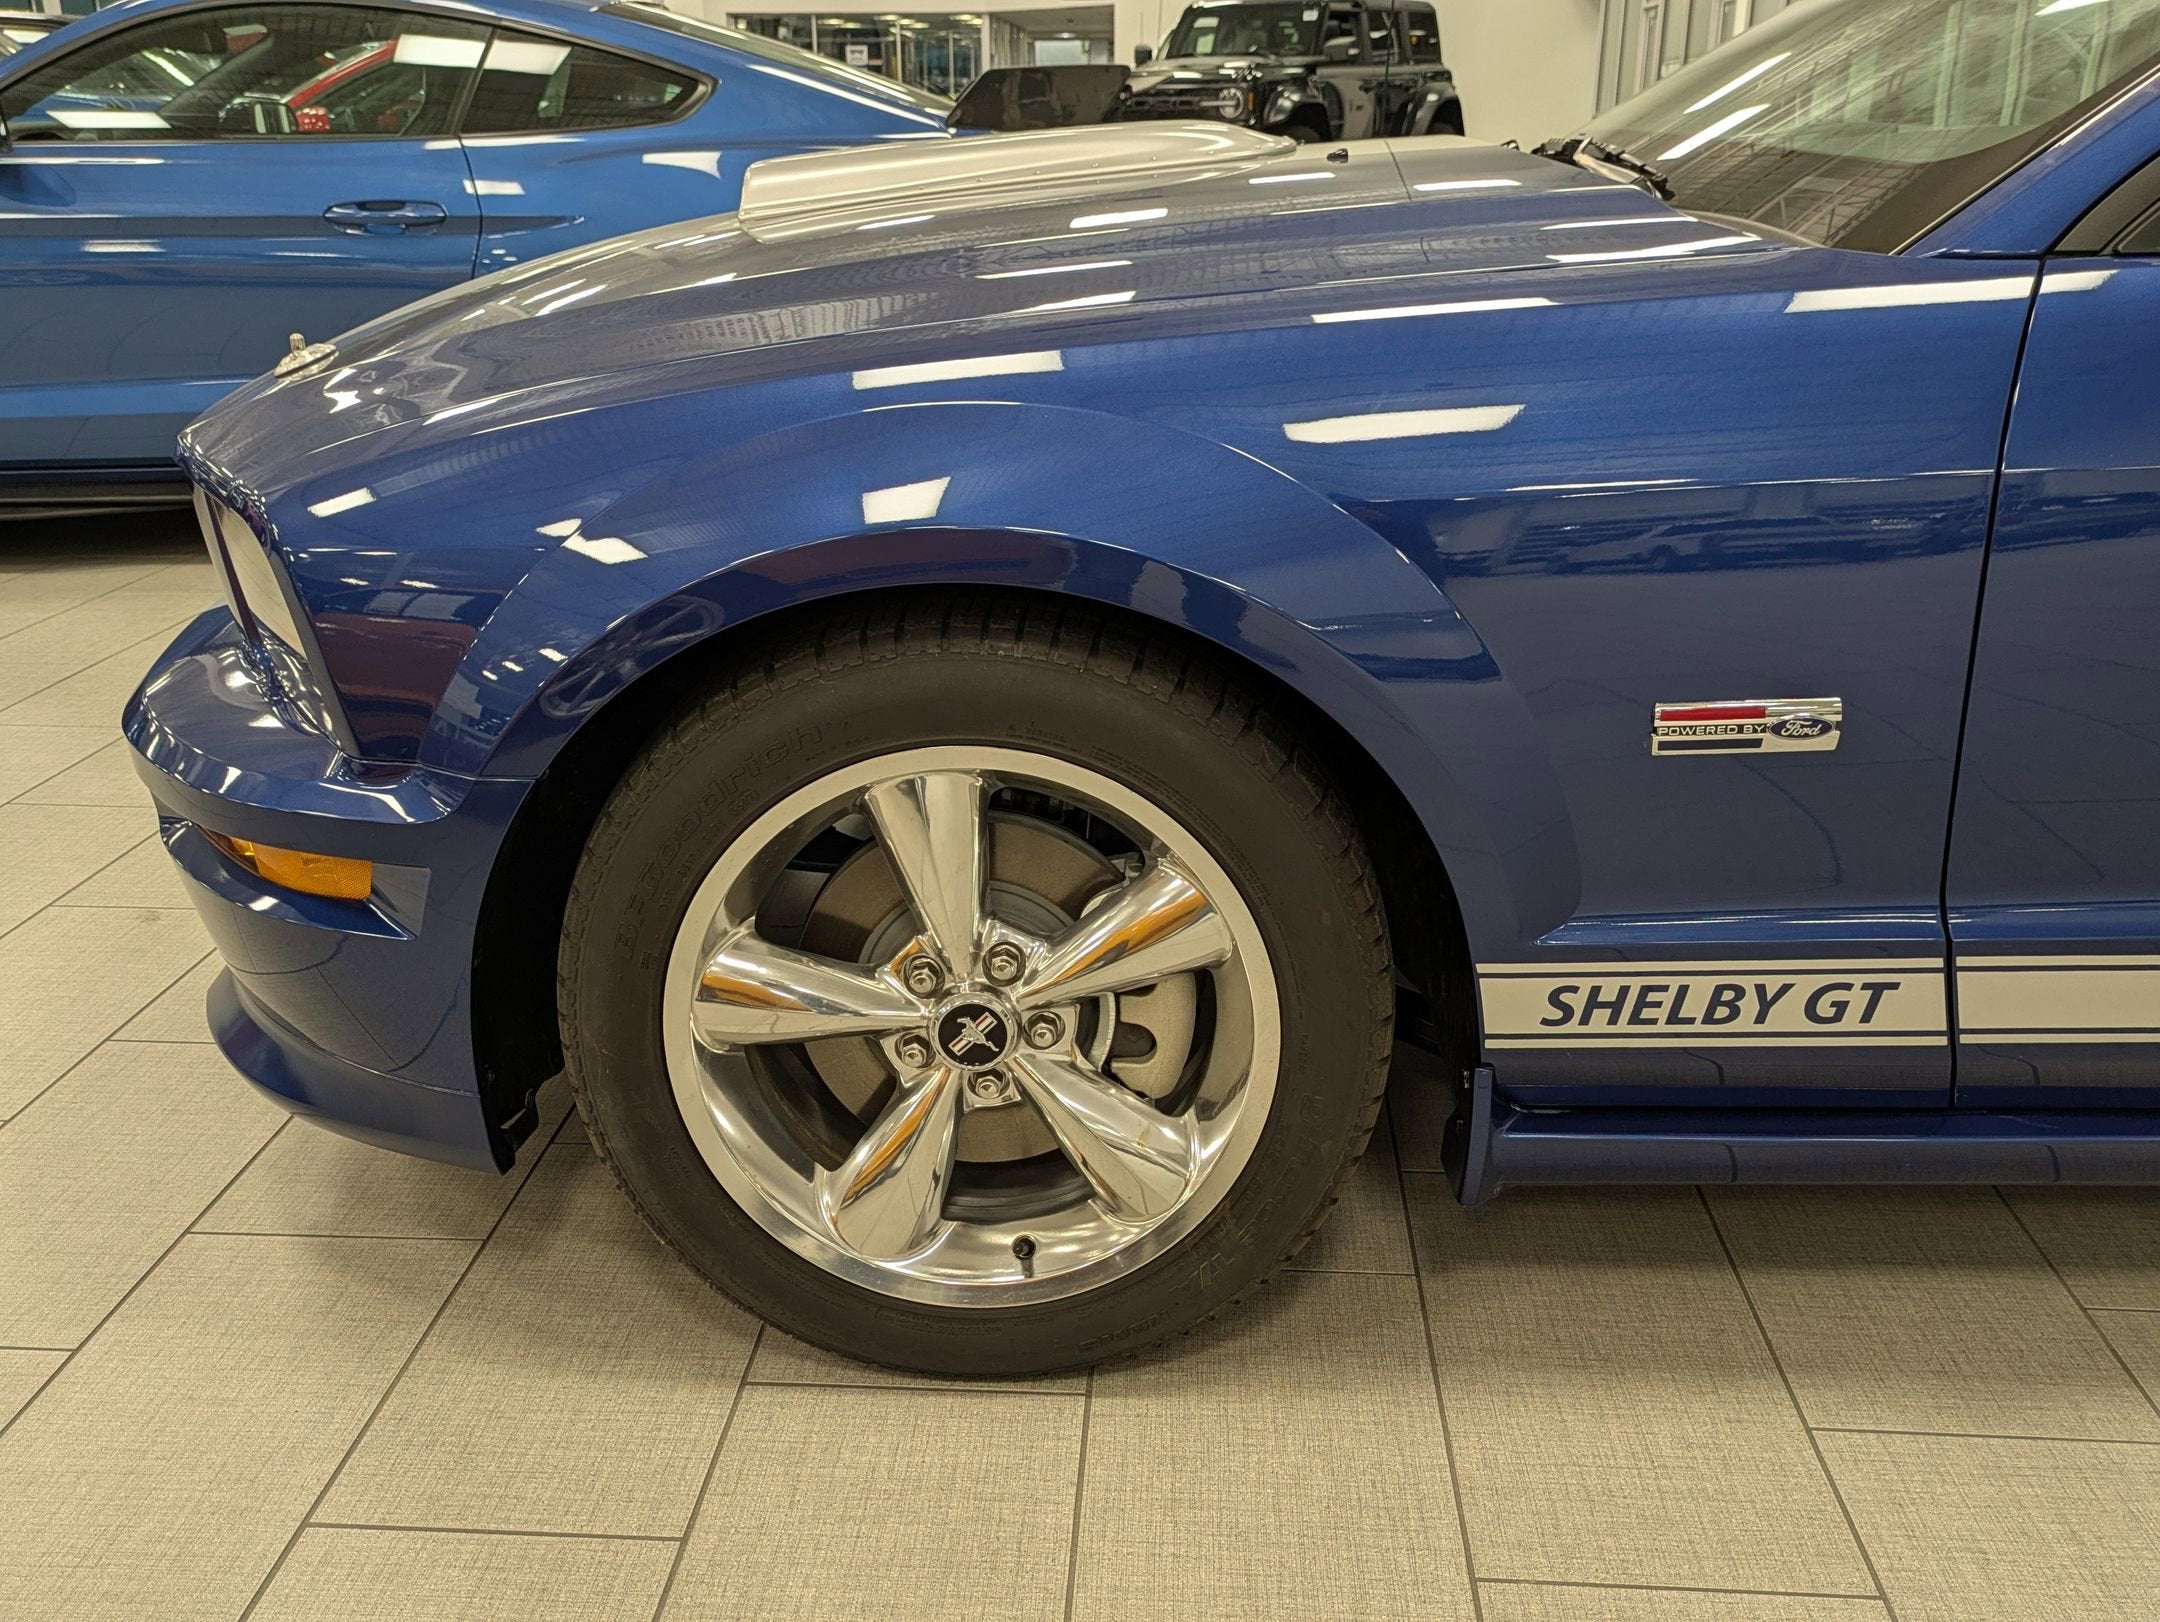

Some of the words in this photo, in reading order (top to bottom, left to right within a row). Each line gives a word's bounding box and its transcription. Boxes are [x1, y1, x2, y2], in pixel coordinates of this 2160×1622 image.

[1657, 724, 1738, 737] POWERED
[1742, 724, 1766, 735] BY
[1780, 719, 1822, 738] Ford
[1539, 982, 1797, 1028] SHELBY
[1803, 981, 1902, 1026] GT
